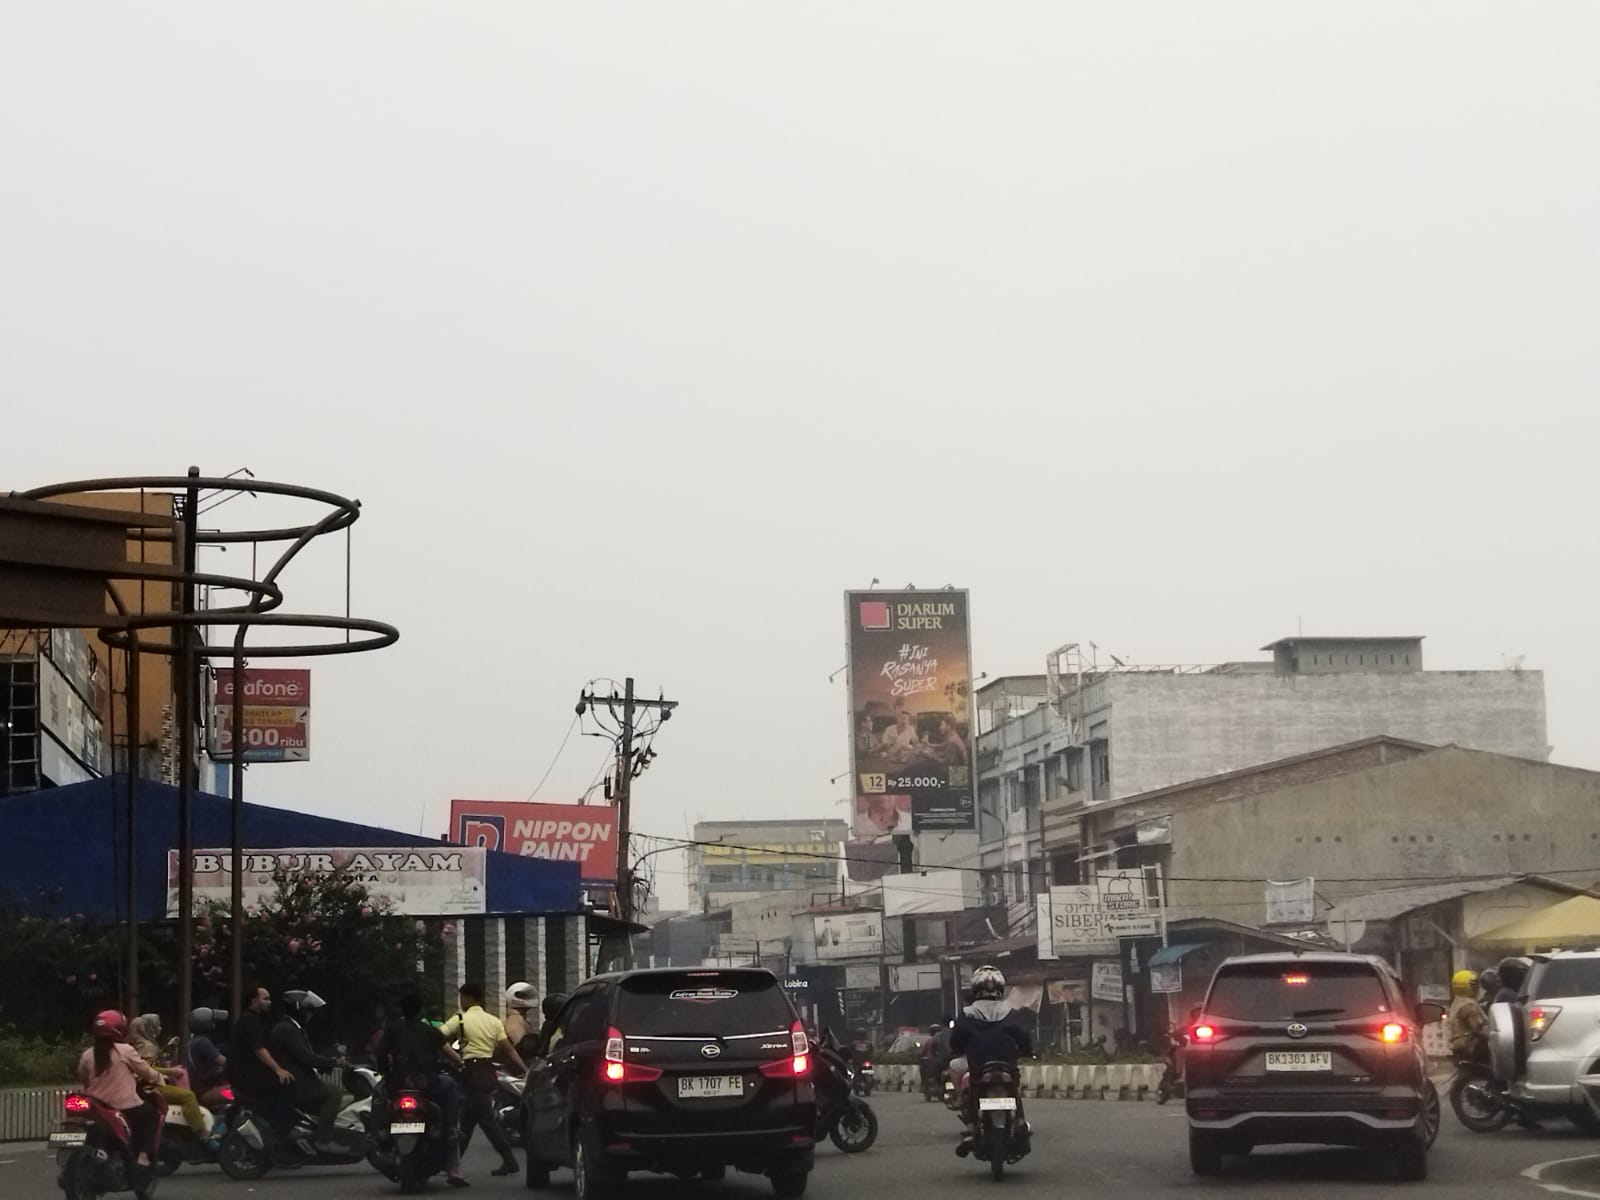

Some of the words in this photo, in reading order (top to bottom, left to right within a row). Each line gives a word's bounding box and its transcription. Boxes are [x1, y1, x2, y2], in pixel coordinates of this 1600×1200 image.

[897, 603, 955, 616] DJARUM
[898, 617, 942, 629] SUPER
[880, 659, 938, 680] RASANYA
[224, 680, 298, 696] eafone
[891, 677, 937, 697] SUPER
[281, 738, 304, 747] ribu
[870, 776, 883, 787] 12
[898, 777, 946, 788] 25.000,-
[513, 819, 611, 842] NIPPON
[519, 840, 595, 862] PAINT
[193, 854, 336, 873] BUBUR
[345, 853, 462, 872] AYAM
[1065, 903, 1101, 914] OPTI
[681, 1078, 694, 1091] BK
[700, 1077, 722, 1090] 1707
[728, 1077, 741, 1089] FE
